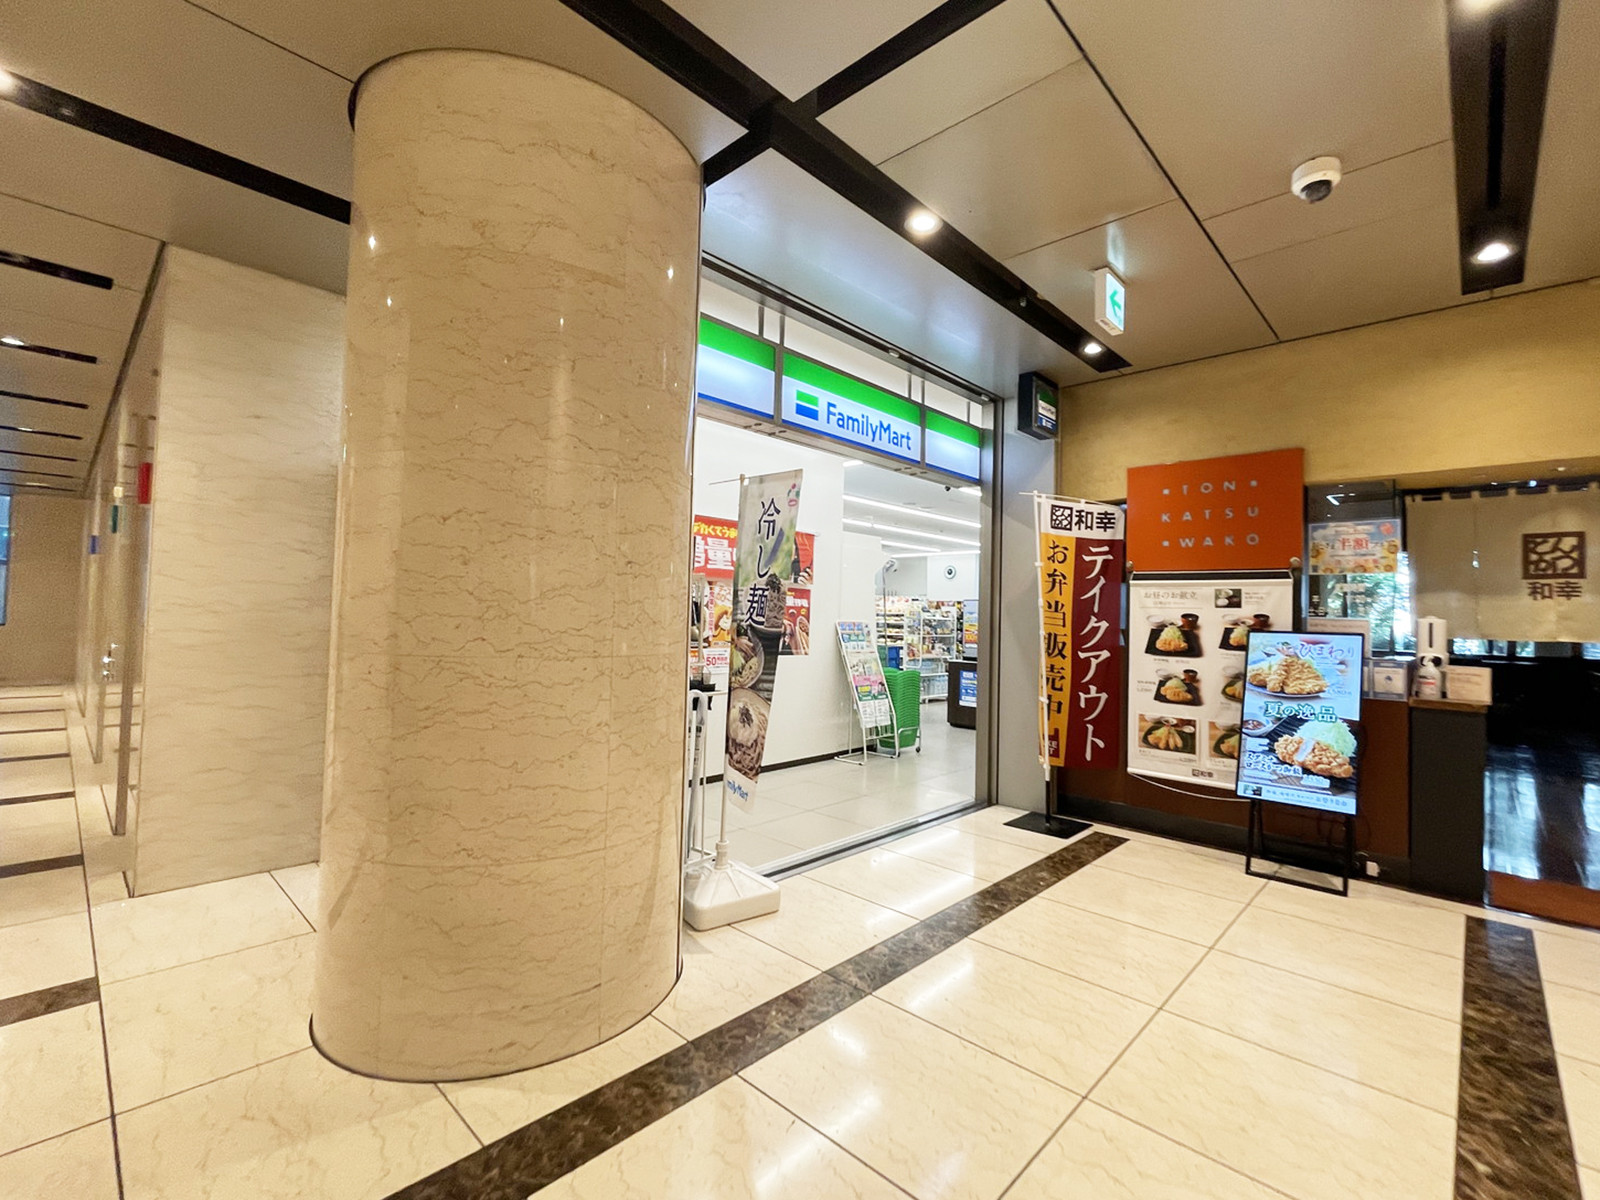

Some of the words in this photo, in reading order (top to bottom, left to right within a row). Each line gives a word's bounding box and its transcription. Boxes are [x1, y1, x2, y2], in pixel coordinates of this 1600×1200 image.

[827, 401, 911, 451] FamilyMart
[1182, 480, 1236, 496] TON
[1075, 510, 1116, 532] 和幸
[1161, 505, 1259, 522] KATSU
[1179, 533, 1259, 548] WAKO
[745, 497, 781, 626] 冷し麺
[1527, 580, 1582, 600] 和幸
[1077, 545, 1114, 762] テイクアウト
[1300, 643, 1354, 660] ひまわり
[1264, 701, 1337, 722] 夏の逸品
